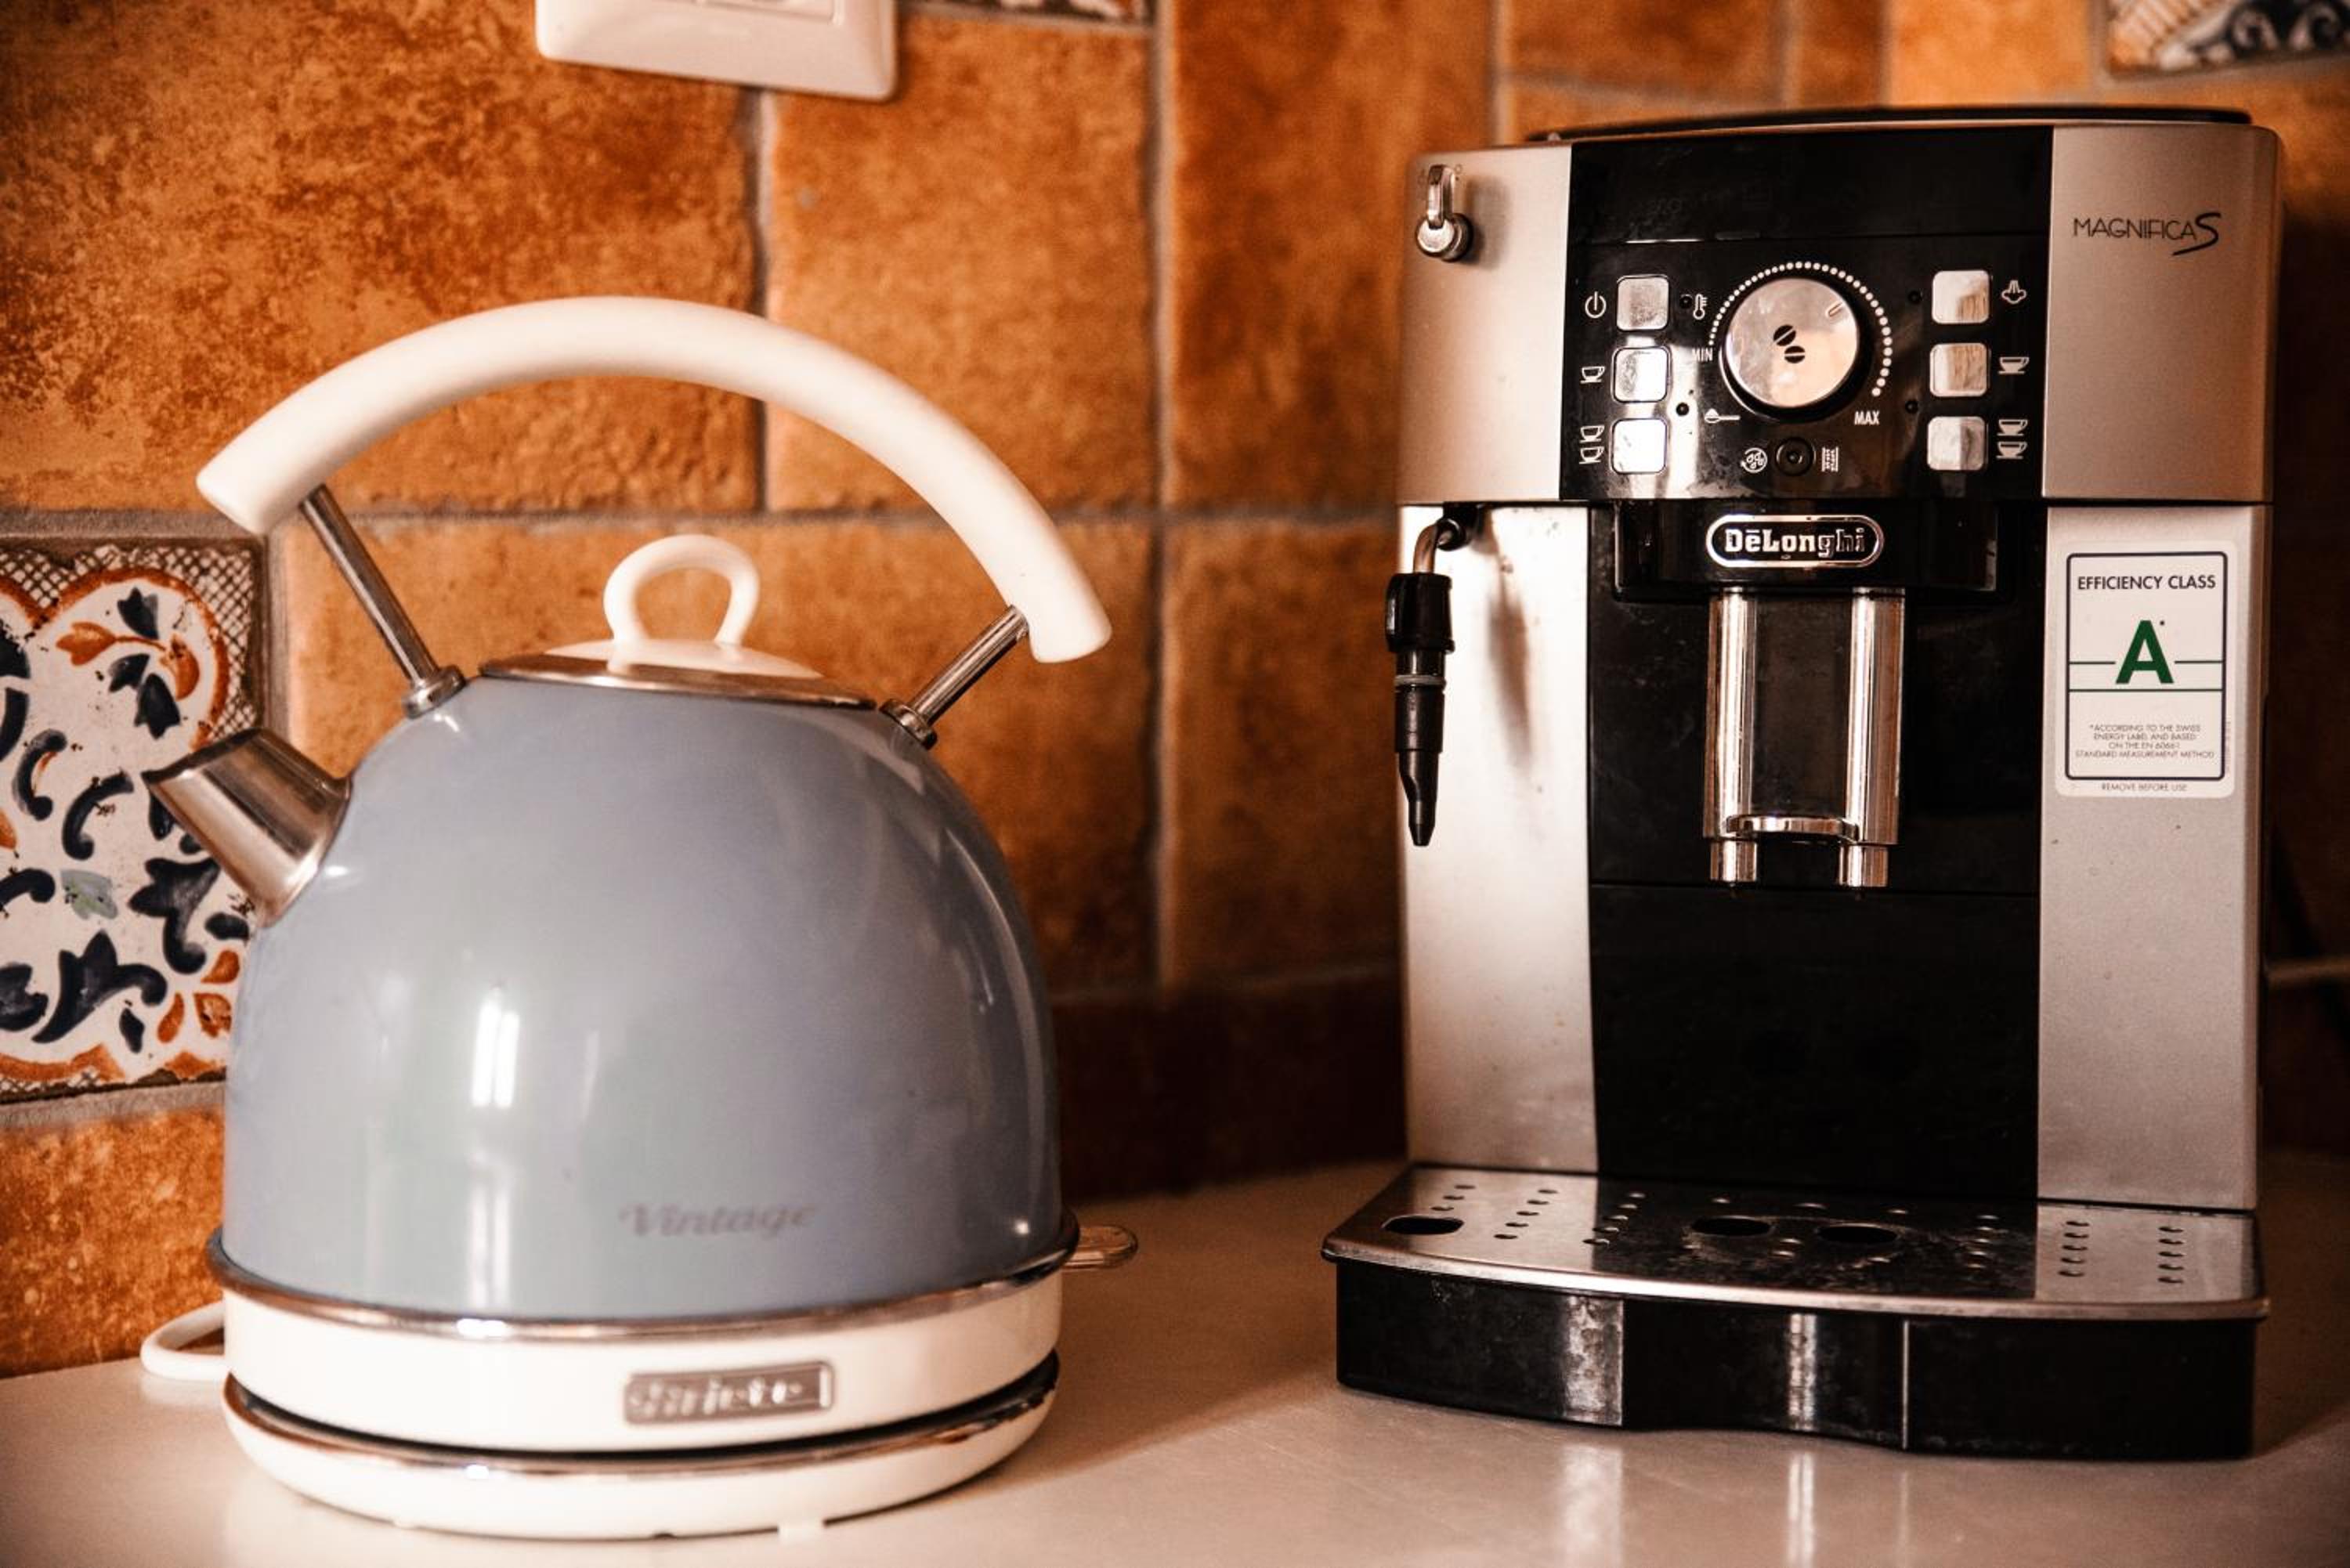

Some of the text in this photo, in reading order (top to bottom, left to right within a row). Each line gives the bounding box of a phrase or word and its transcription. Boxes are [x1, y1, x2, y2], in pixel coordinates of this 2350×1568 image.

[1690, 348, 1713, 362] MIN
[1854, 410, 1880, 426] MAX
[2077, 575, 2216, 590] EFFICIENCY CLASS
[617, 1205, 817, 1241] Vintage
